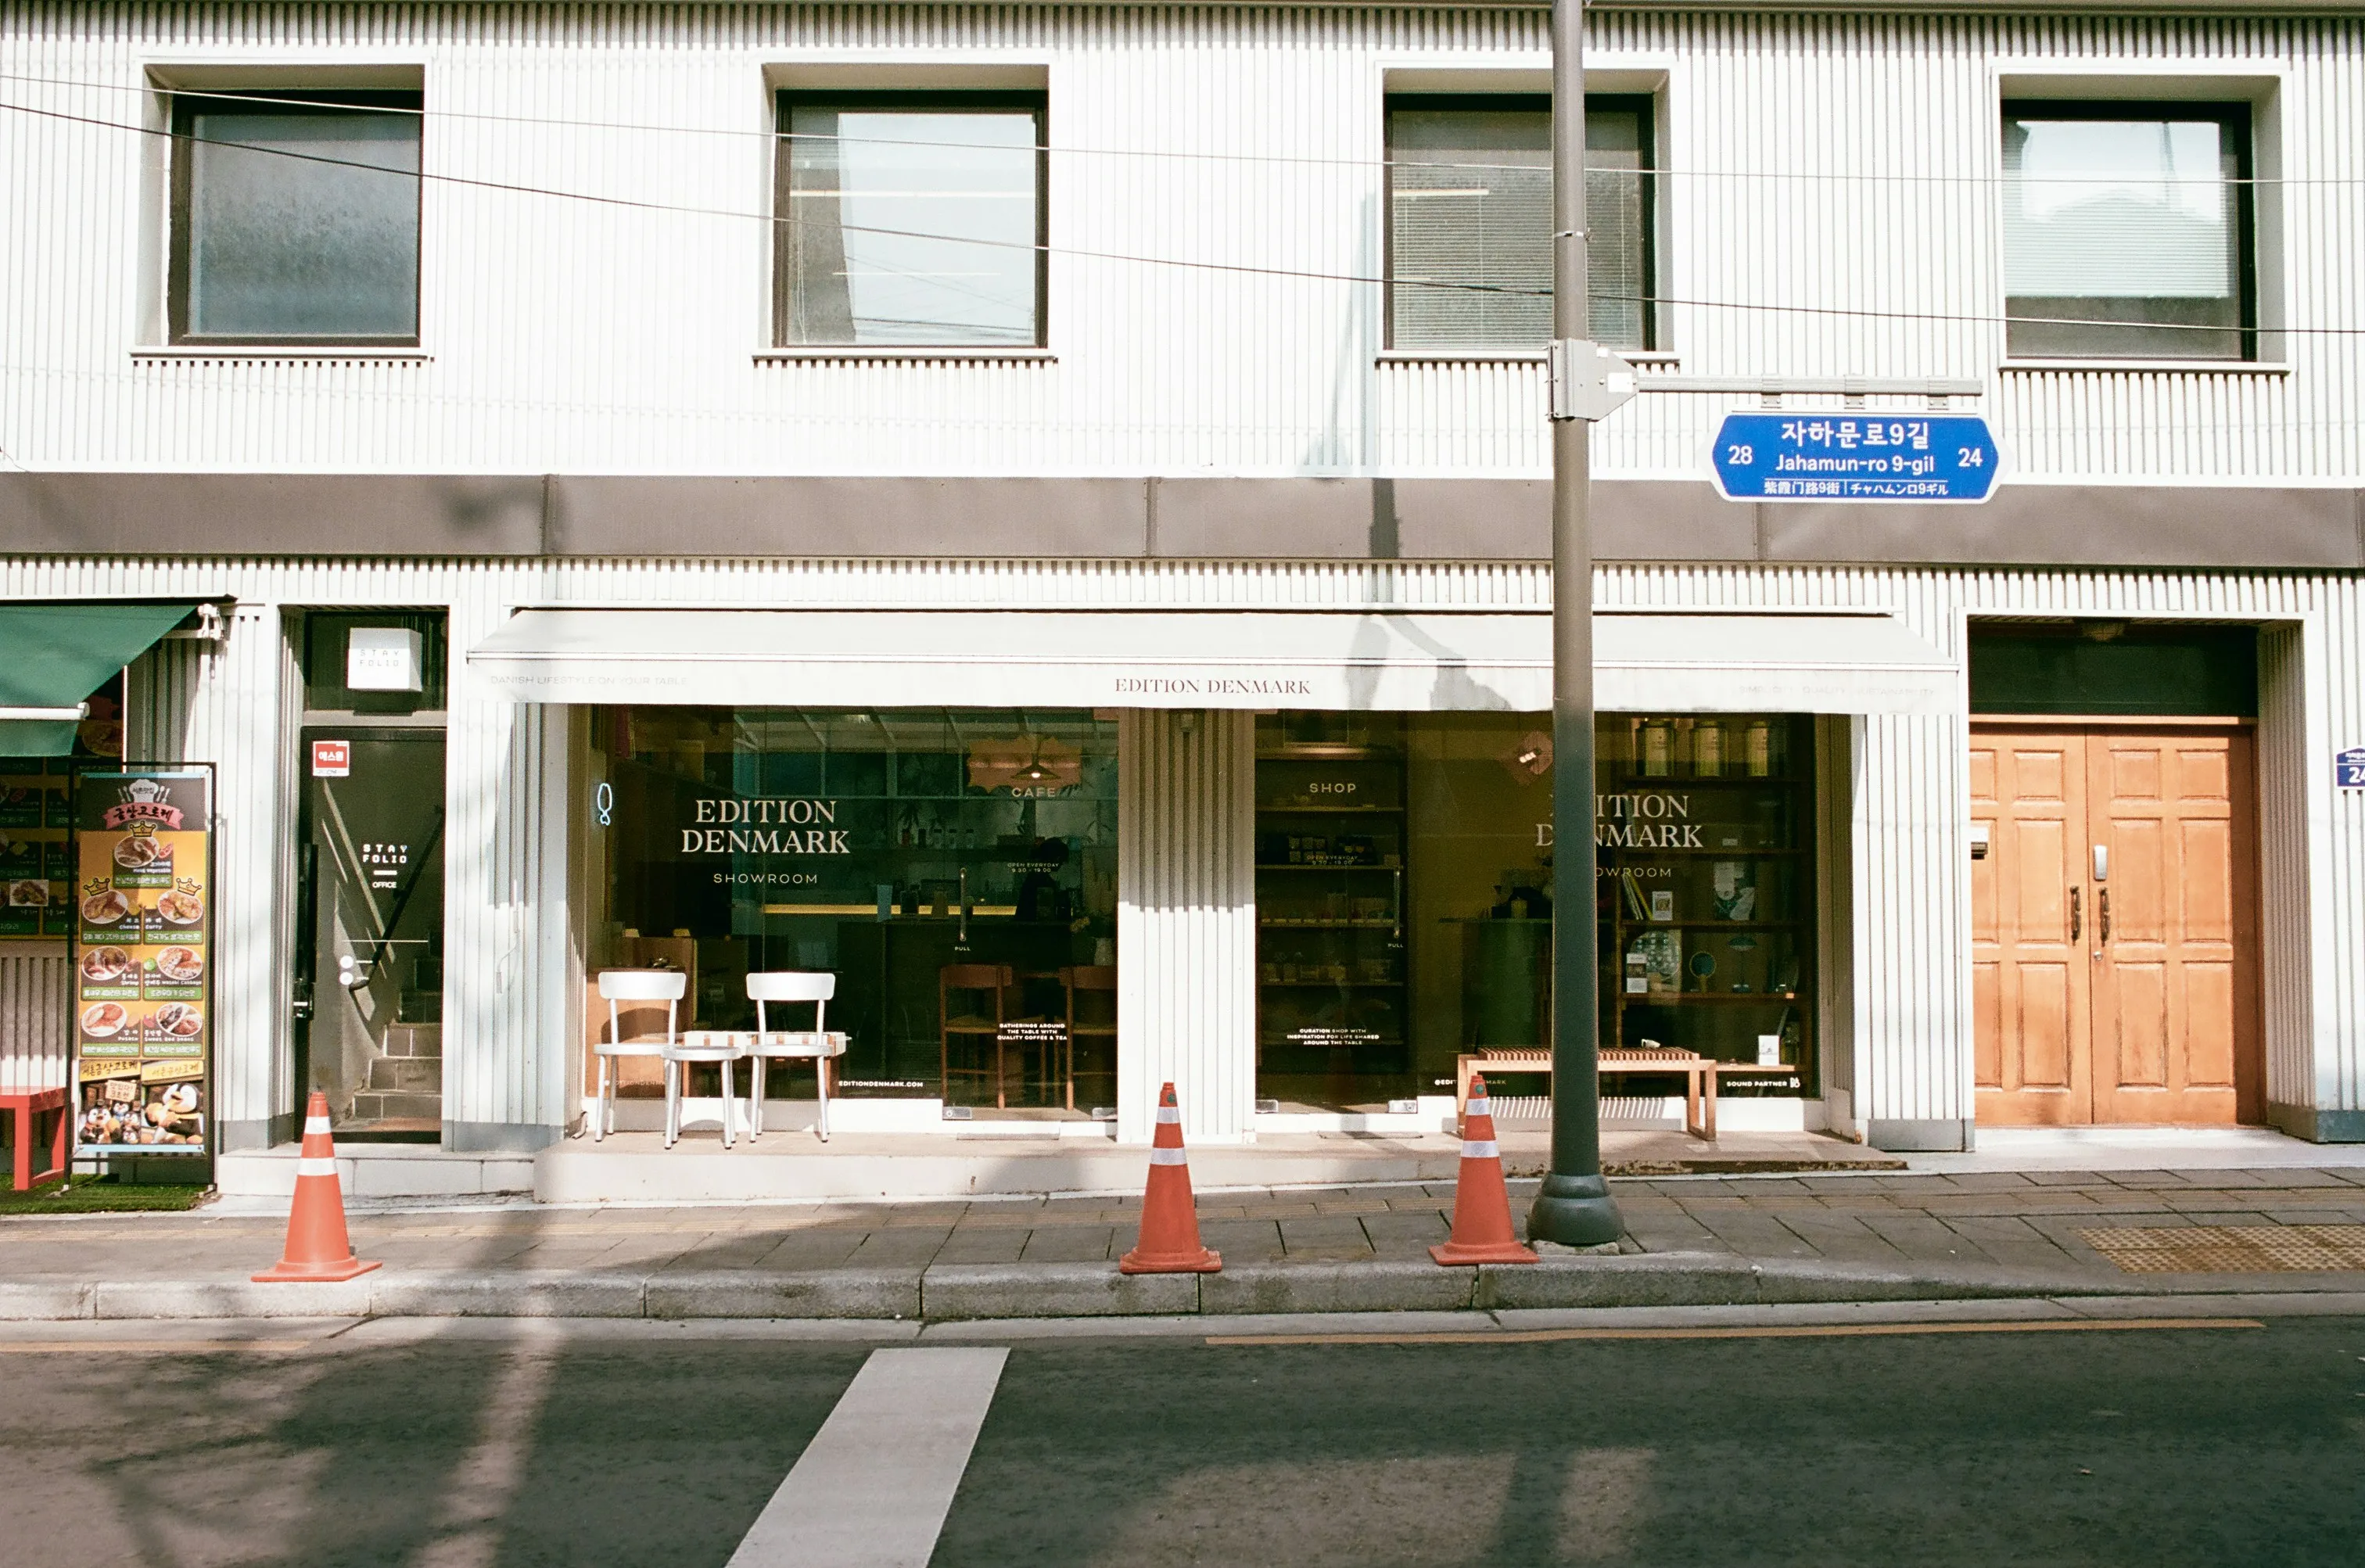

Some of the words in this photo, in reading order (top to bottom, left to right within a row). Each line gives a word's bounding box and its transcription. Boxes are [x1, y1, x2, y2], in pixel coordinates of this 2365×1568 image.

[1781, 420, 1929, 450] 자하문로9길
[1728, 446, 1753, 465] 28
[1958, 448, 1983, 467] 24
[1775, 454, 1887, 472] Jahamun-ro
[1893, 455, 1934, 475] 9-gil
[490, 676, 534, 684] DANISH
[537, 676, 594, 685] LIFESTYLE
[598, 676, 615, 685] ON
[655, 676, 687, 685] TABLE
[1115, 679, 1199, 693] EDITION
[1208, 680, 1311, 694] DENMARK
[318, 751, 343, 762] 에스원
[1011, 788, 1056, 798] CAFE
[1309, 783, 1357, 793] SHOP
[113, 806, 174, 822] 금상고로케
[695, 800, 836, 823] EDITION
[1549, 795, 1689, 818] ITION
[681, 830, 850, 854] DENMARK
[1536, 823, 1704, 848] DMARK
[363, 844, 407, 852] STAY
[363, 855, 407, 864] FOLIO
[713, 874, 817, 884] SHOWROOM
[1595, 867, 1671, 877] OWROOM
